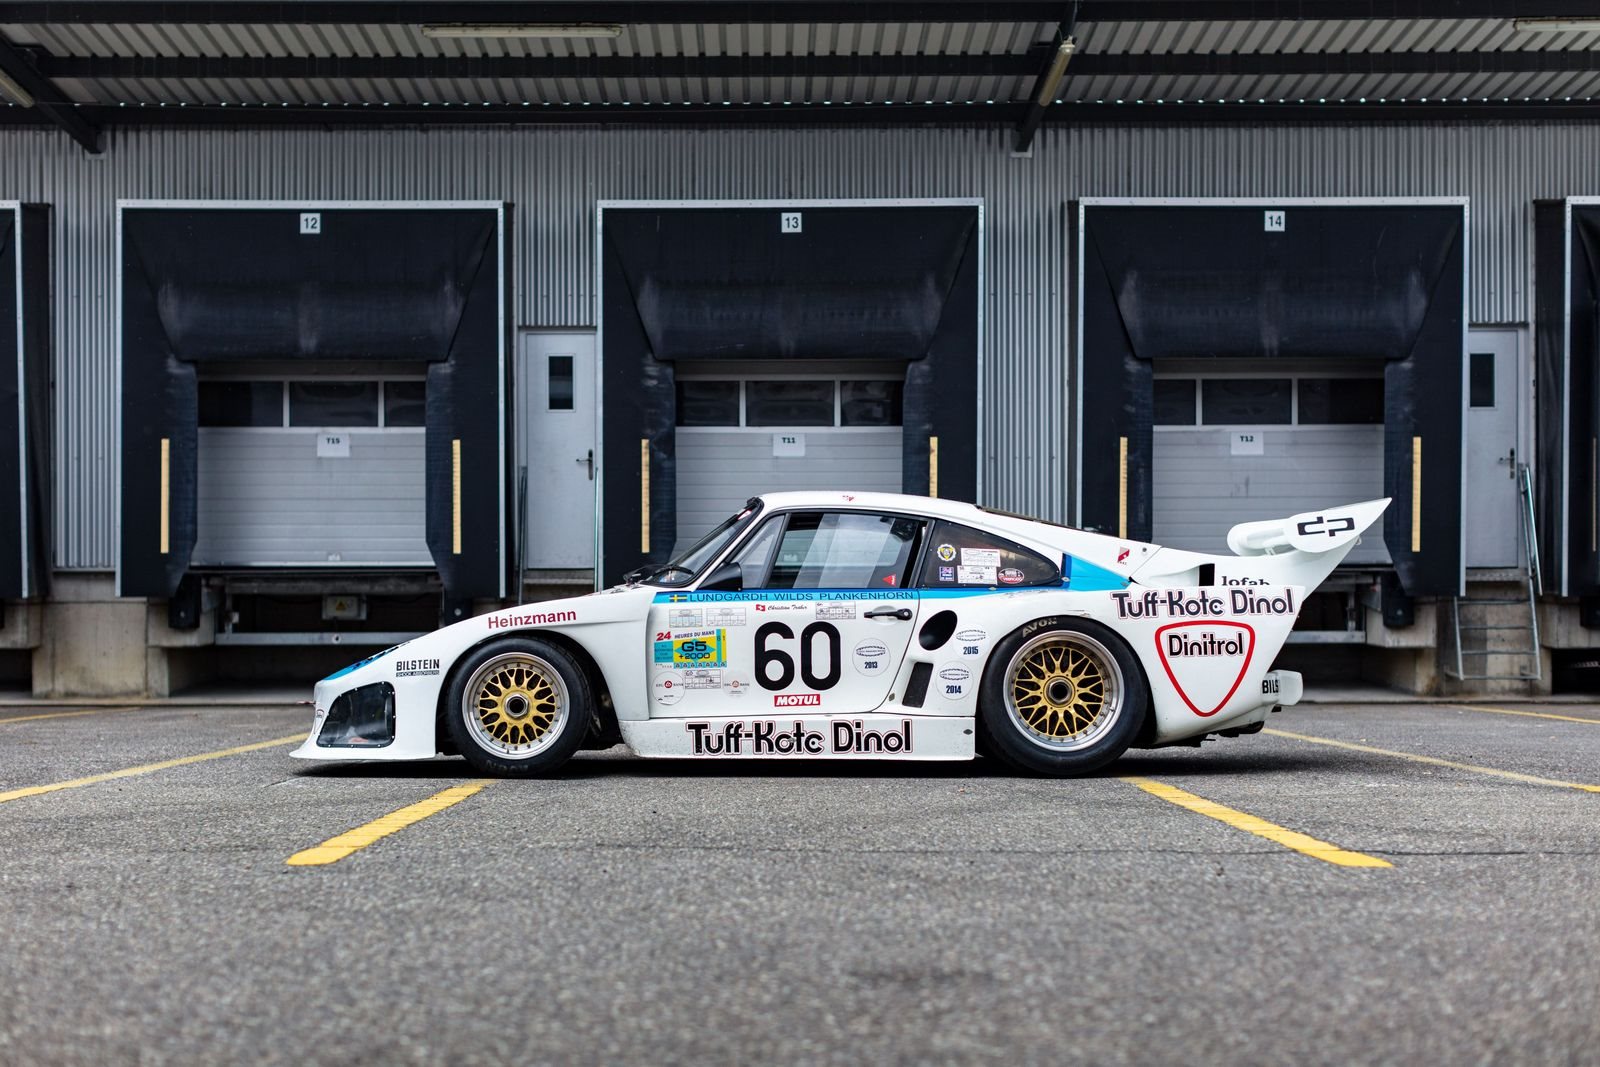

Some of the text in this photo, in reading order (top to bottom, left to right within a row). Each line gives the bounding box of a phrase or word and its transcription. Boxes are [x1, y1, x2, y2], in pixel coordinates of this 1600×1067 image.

[304, 216, 318, 229] 12
[785, 216, 799, 229] 13
[1268, 215, 1282, 227] 14
[690, 592, 913, 602] LUNDGARDH WILDS PLANKENHORN
[1111, 587, 1295, 618] Tuff-Kote Dinol
[488, 611, 577, 629] Heinzmann
[1023, 617, 1057, 638] AVON
[656, 631, 671, 641] 24
[681, 641, 707, 652] G5
[963, 646, 979, 655] 2015
[1167, 632, 1244, 657] Dinitrol
[754, 621, 841, 691] 60
[396, 659, 440, 671] BILSTEIN
[946, 685, 962, 694] 2014
[776, 695, 820, 706] MOTUL
[686, 719, 913, 755] Tuff-Kote Dinol
